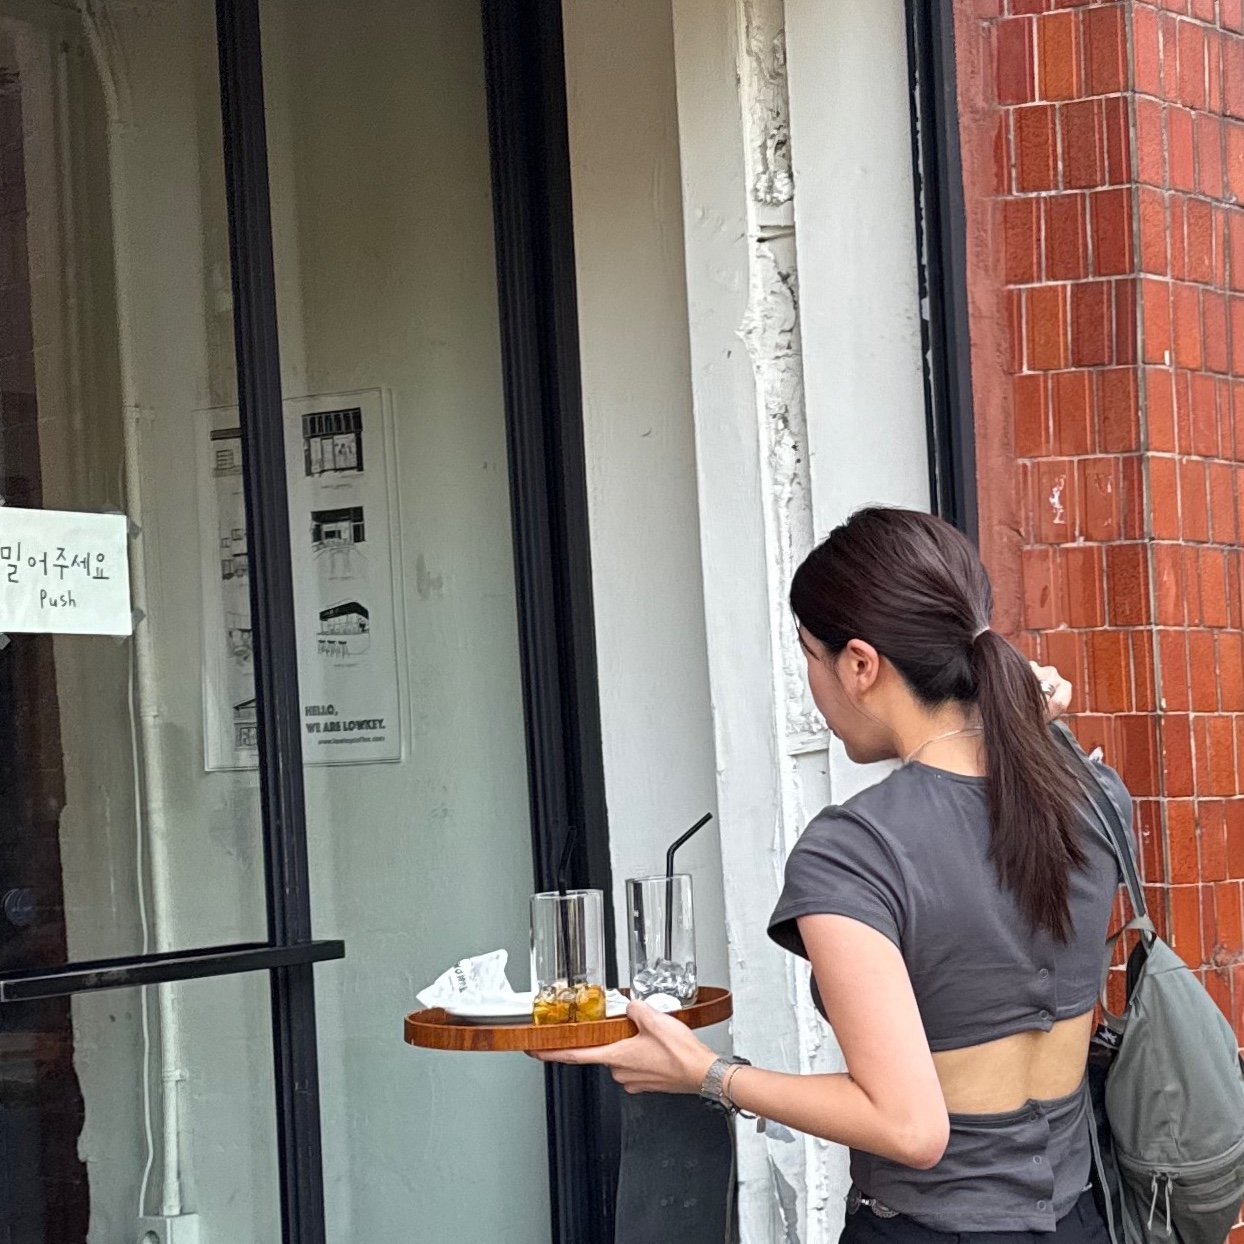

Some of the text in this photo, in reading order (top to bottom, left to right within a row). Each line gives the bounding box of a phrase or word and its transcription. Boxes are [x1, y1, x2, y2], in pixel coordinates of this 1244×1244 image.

[1, 541, 110, 584] 밀어주세요
[40, 588, 76, 608] Push
[304, 704, 339, 717] HELLO,
[305, 722, 321, 733] WE
[323, 721, 341, 733] ARE
